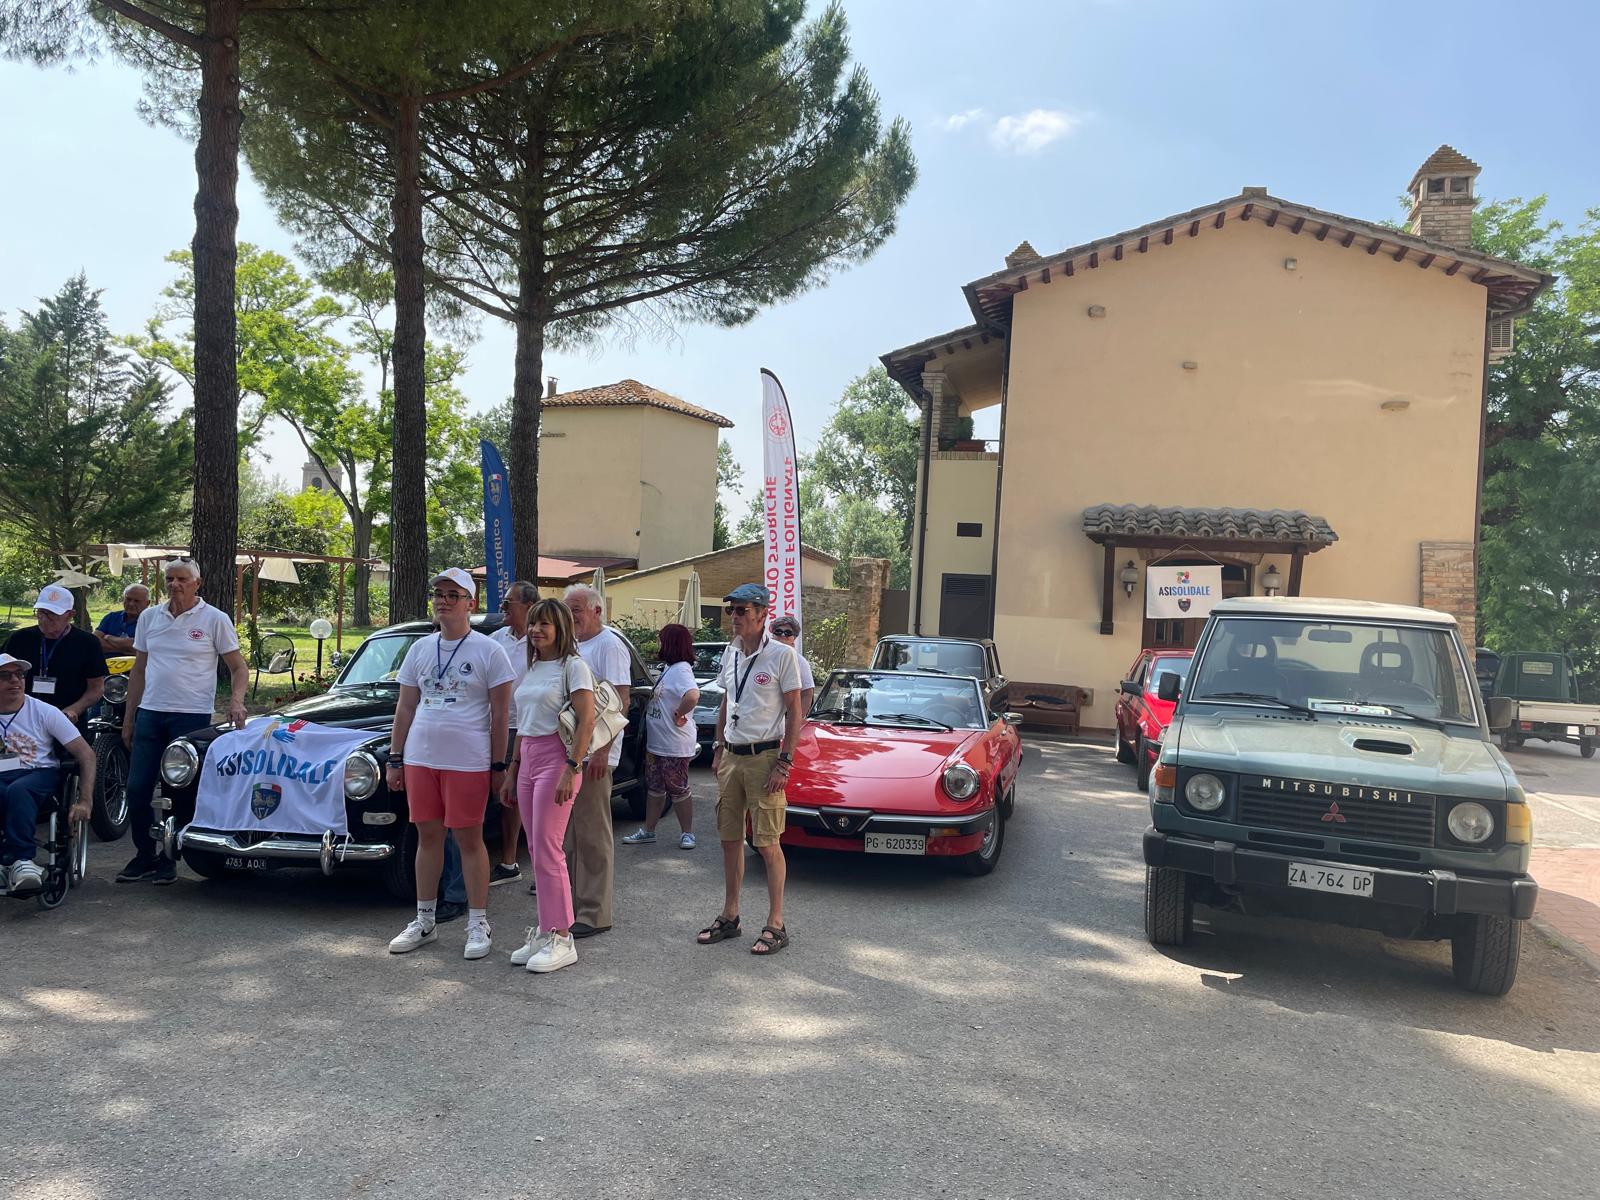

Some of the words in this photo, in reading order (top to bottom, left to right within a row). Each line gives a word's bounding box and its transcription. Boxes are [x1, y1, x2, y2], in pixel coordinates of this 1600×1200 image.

[493, 518, 504, 577] STORICO
[1159, 586, 1211, 596] ASISOLIDALE
[216, 749, 338, 785] ASISOLIDALE
[1262, 778, 1412, 803] MITSUBISHI
[866, 837, 879, 849] PG
[886, 838, 924, 850] 620339
[1289, 867, 1307, 883] ZA
[1316, 871, 1345, 888] 764
[1352, 876, 1372, 891] DP
